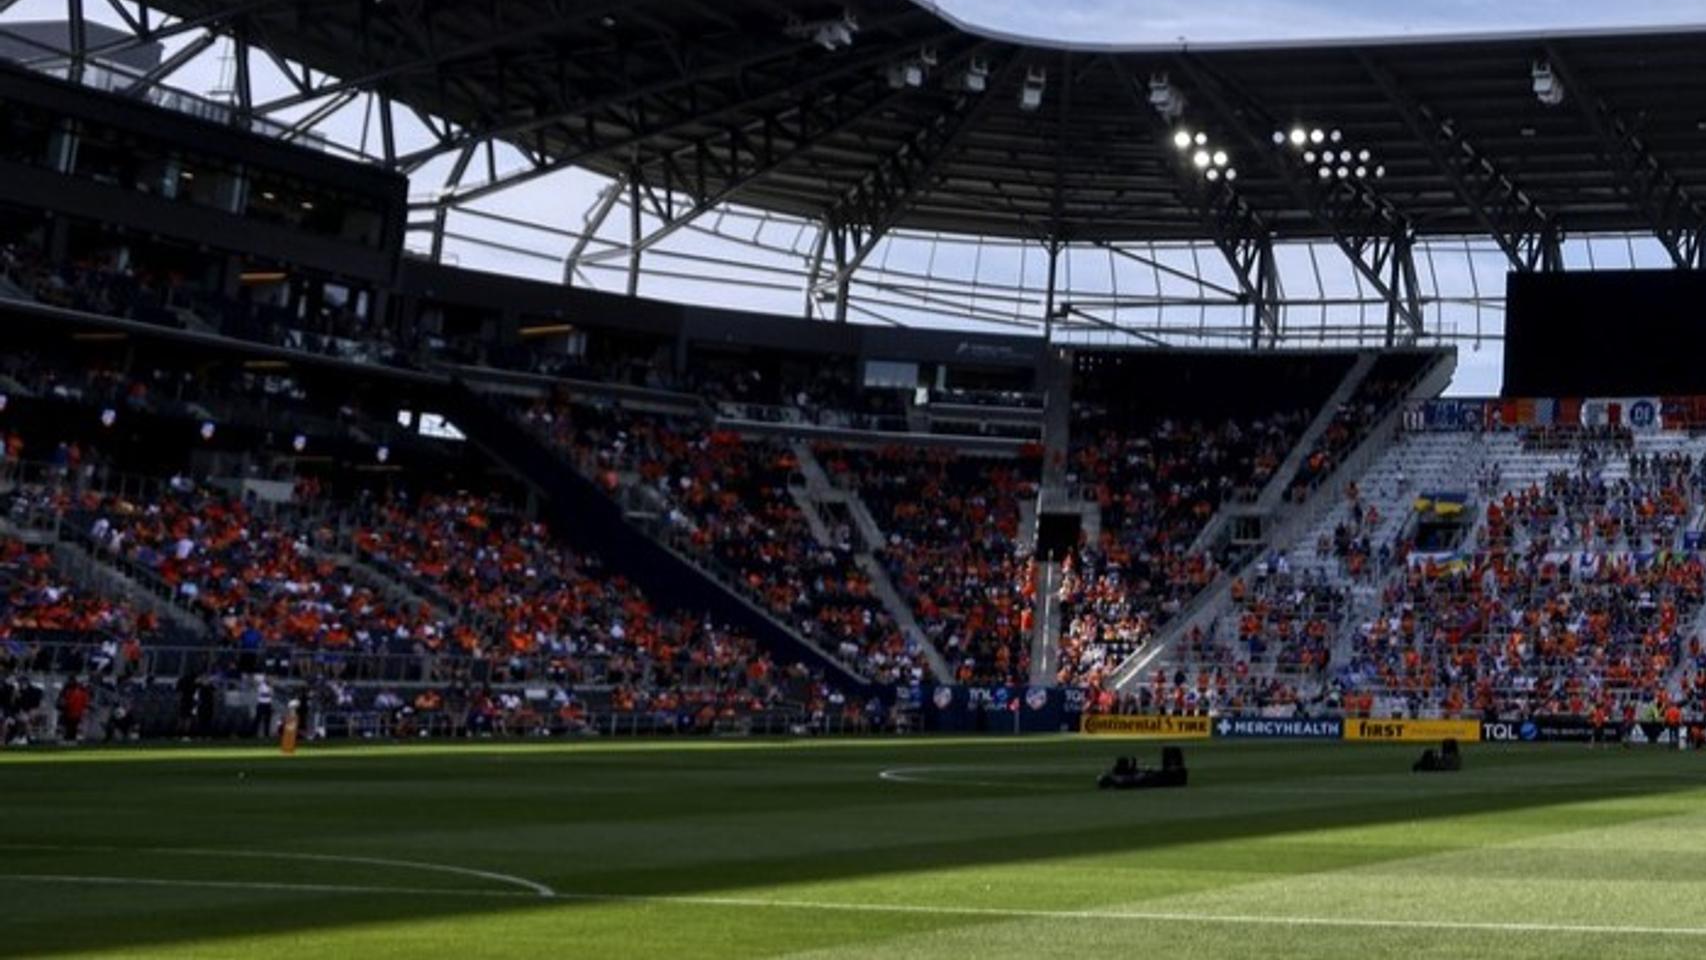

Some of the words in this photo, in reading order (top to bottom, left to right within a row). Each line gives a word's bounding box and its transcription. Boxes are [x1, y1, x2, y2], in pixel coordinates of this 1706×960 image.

[1178, 719, 1207, 732] TIRE
[1234, 719, 1340, 735] MERCYHEALTH
[1483, 723, 1519, 740] TQL
